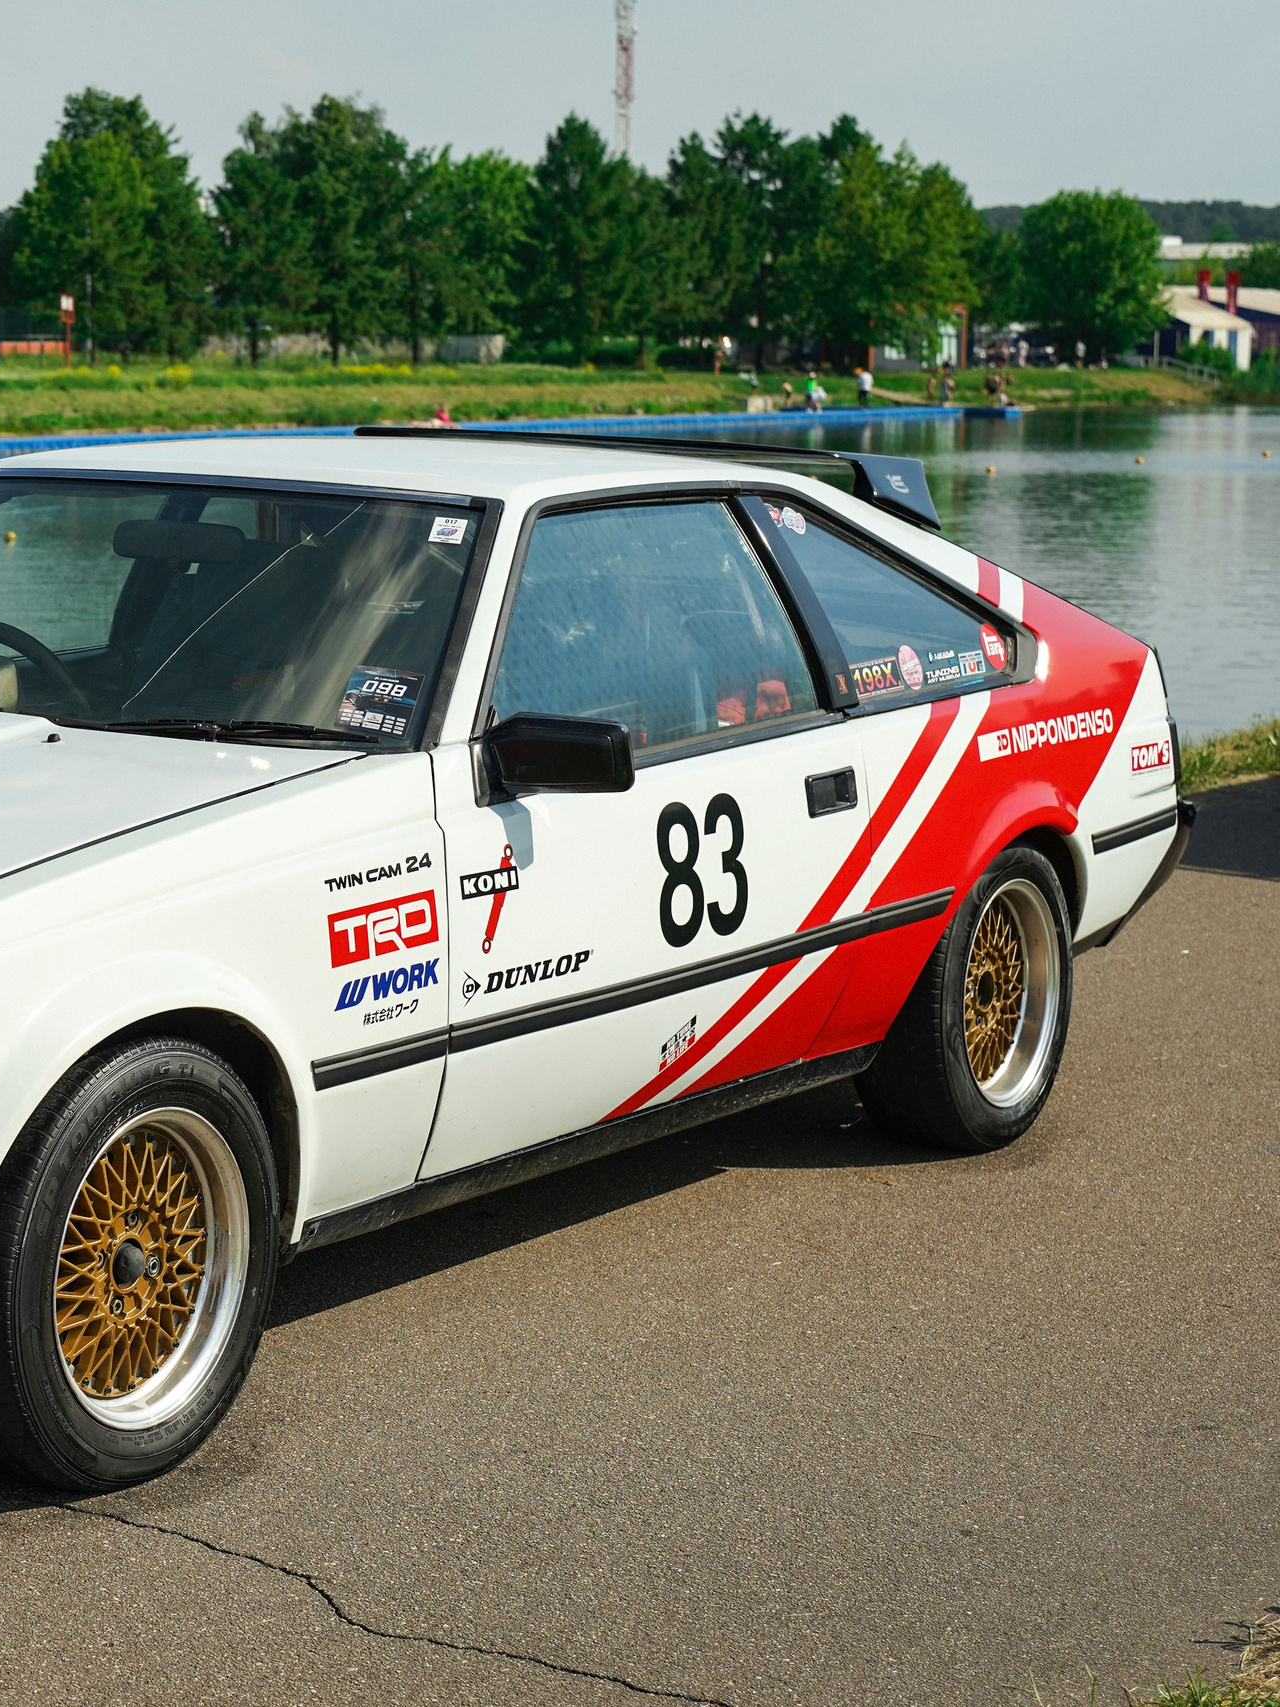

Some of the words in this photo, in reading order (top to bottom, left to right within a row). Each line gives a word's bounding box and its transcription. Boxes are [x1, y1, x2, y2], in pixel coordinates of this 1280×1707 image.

[361, 680, 408, 697] 098
[853, 662, 898, 693] 198X
[925, 665, 960, 679] TUNING
[1011, 708, 1114, 754] NIPPONDENSO
[1132, 742, 1170, 769] TOM'S
[324, 872, 363, 893] TWIN
[366, 862, 403, 882] CAM
[405, 852, 432, 874] 24
[463, 869, 518, 897] KONI
[656, 792, 749, 948] 83
[333, 899, 433, 957] TRD
[372, 957, 440, 1001] WORK
[483, 950, 591, 995] DUNLOP
[363, 999, 419, 1026] 株式会社ワーク
[63, 1060, 172, 1171] TOURING
